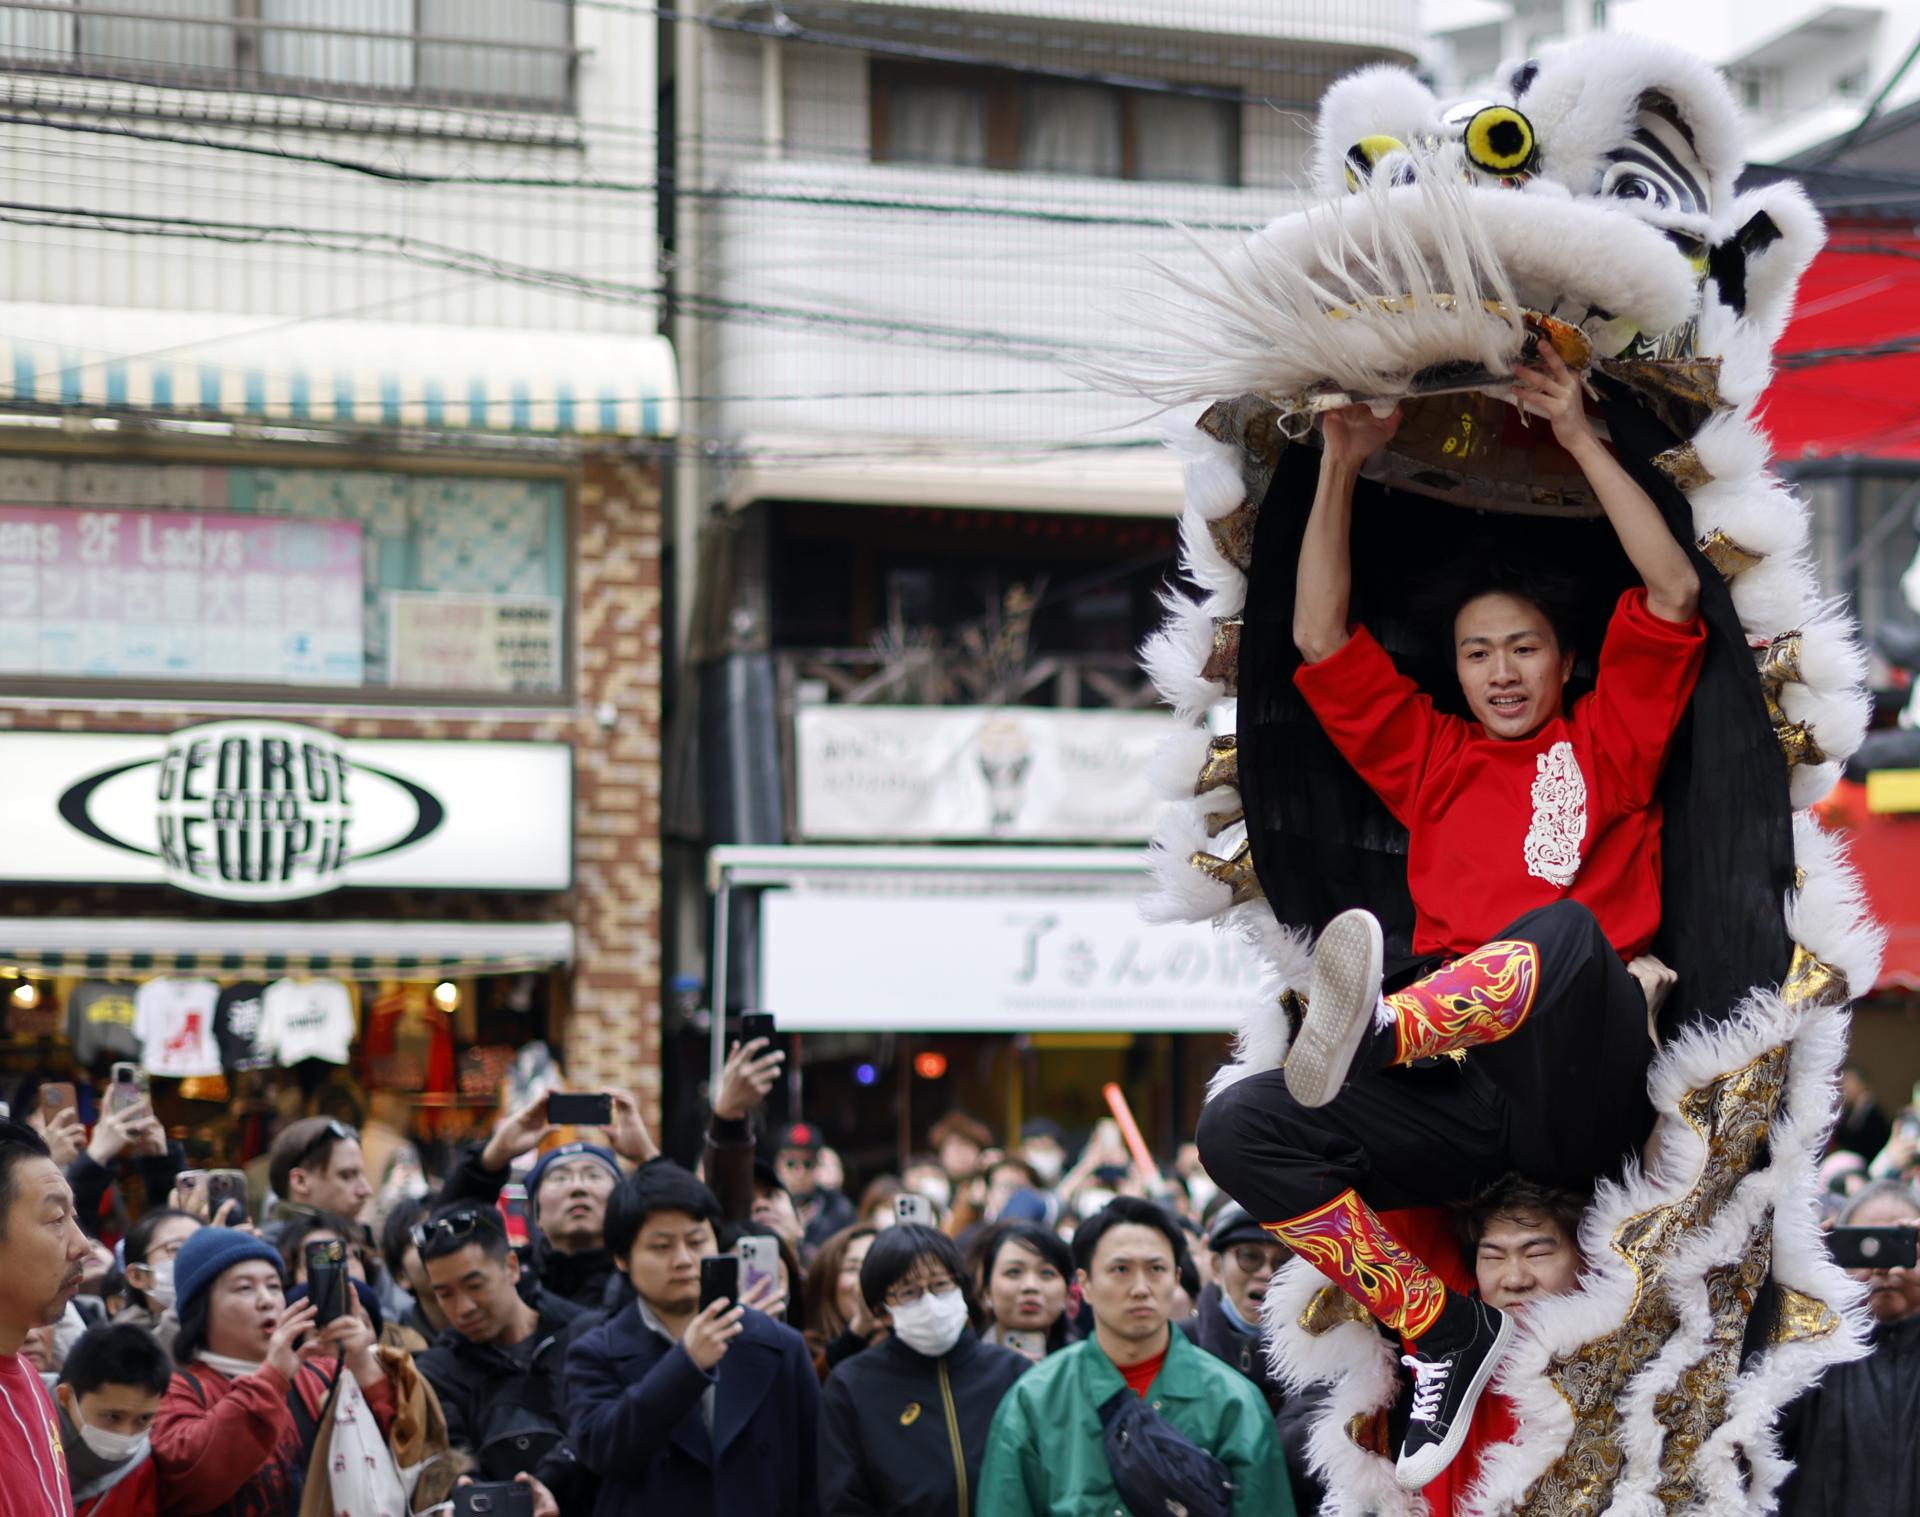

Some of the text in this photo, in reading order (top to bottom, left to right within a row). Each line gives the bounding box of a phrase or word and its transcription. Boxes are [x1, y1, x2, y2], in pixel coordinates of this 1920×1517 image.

[77, 512, 121, 562] 2F
[138, 514, 245, 570] Ladys
[158, 738, 351, 803] GEORGE
